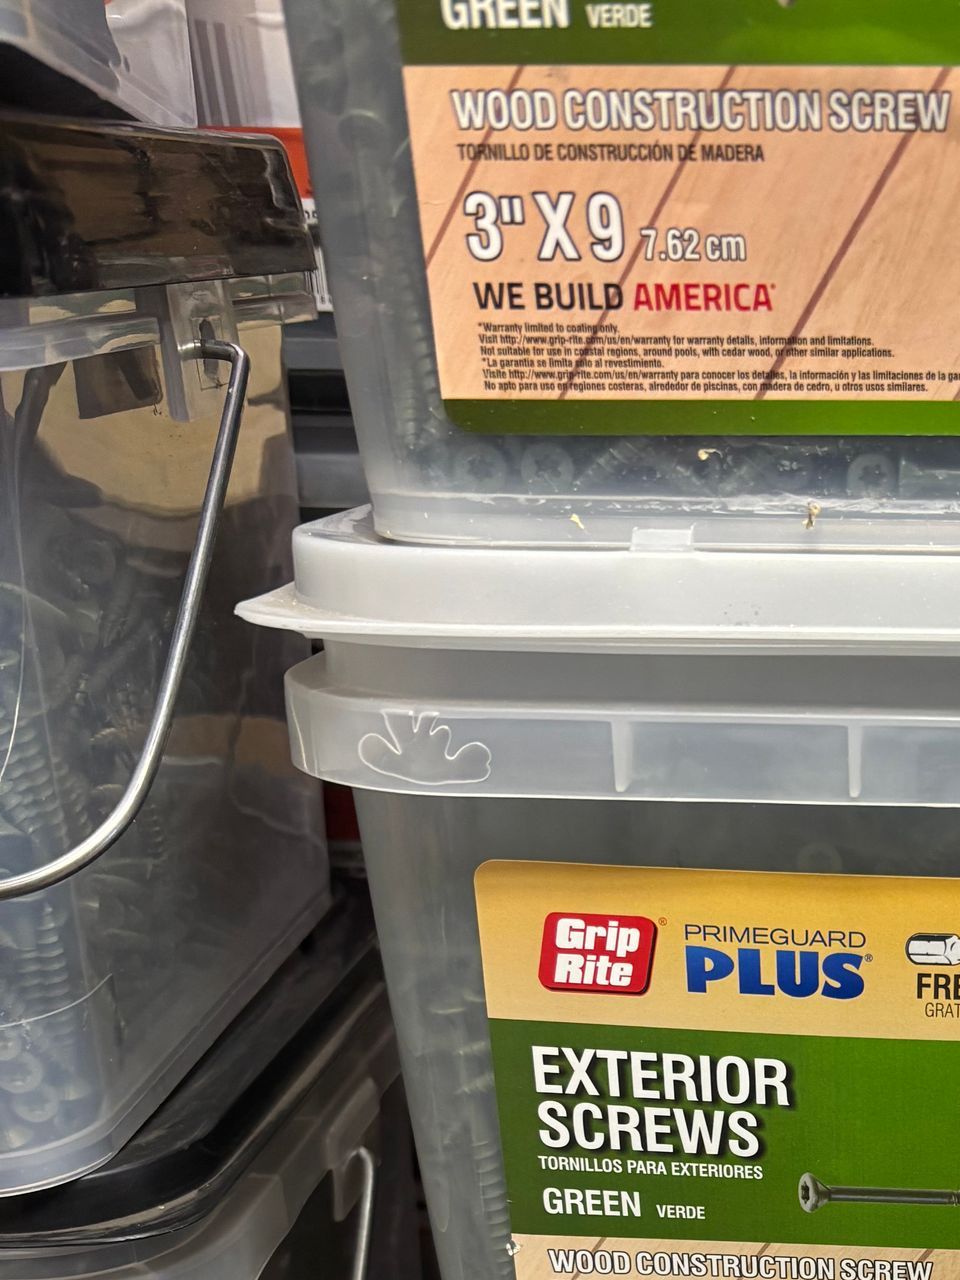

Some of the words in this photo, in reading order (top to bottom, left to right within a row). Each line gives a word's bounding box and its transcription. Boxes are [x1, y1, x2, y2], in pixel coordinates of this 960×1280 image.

[442, 0, 569, 30] GREEN
[587, 4, 651, 29] VERDE
[452, 91, 556, 132] WOOD
[563, 91, 821, 132] CONSTRUCTION
[828, 91, 949, 132] SCREW
[457, 144, 530, 162] TORNILLO
[534, 144, 554, 162] DE
[556, 141, 674, 162] CONSTRUCCIÓN
[678, 145, 697, 162] DE
[700, 144, 764, 162] MADERA
[464, 191, 523, 263] 3"
[537, 193, 579, 262] X
[587, 193, 625, 262] 9
[639, 229, 700, 261] 7.62
[705, 233, 747, 261] cm
[473, 283, 526, 311] WE
[535, 283, 624, 311] BUILD
[633, 283, 771, 311] AMERICA
[555, 917, 640, 954] Grip
[685, 924, 866, 948] PRIMEGUARD
[554, 953, 633, 987] Rite
[685, 947, 865, 999] PLUS
[532, 1046, 790, 1107] EXTERIOR
[539, 1103, 760, 1157] SCREWS
[542, 1188, 640, 1217] GREEN
[656, 1204, 705, 1220] VERDE
[547, 1249, 633, 1276] WOOD
